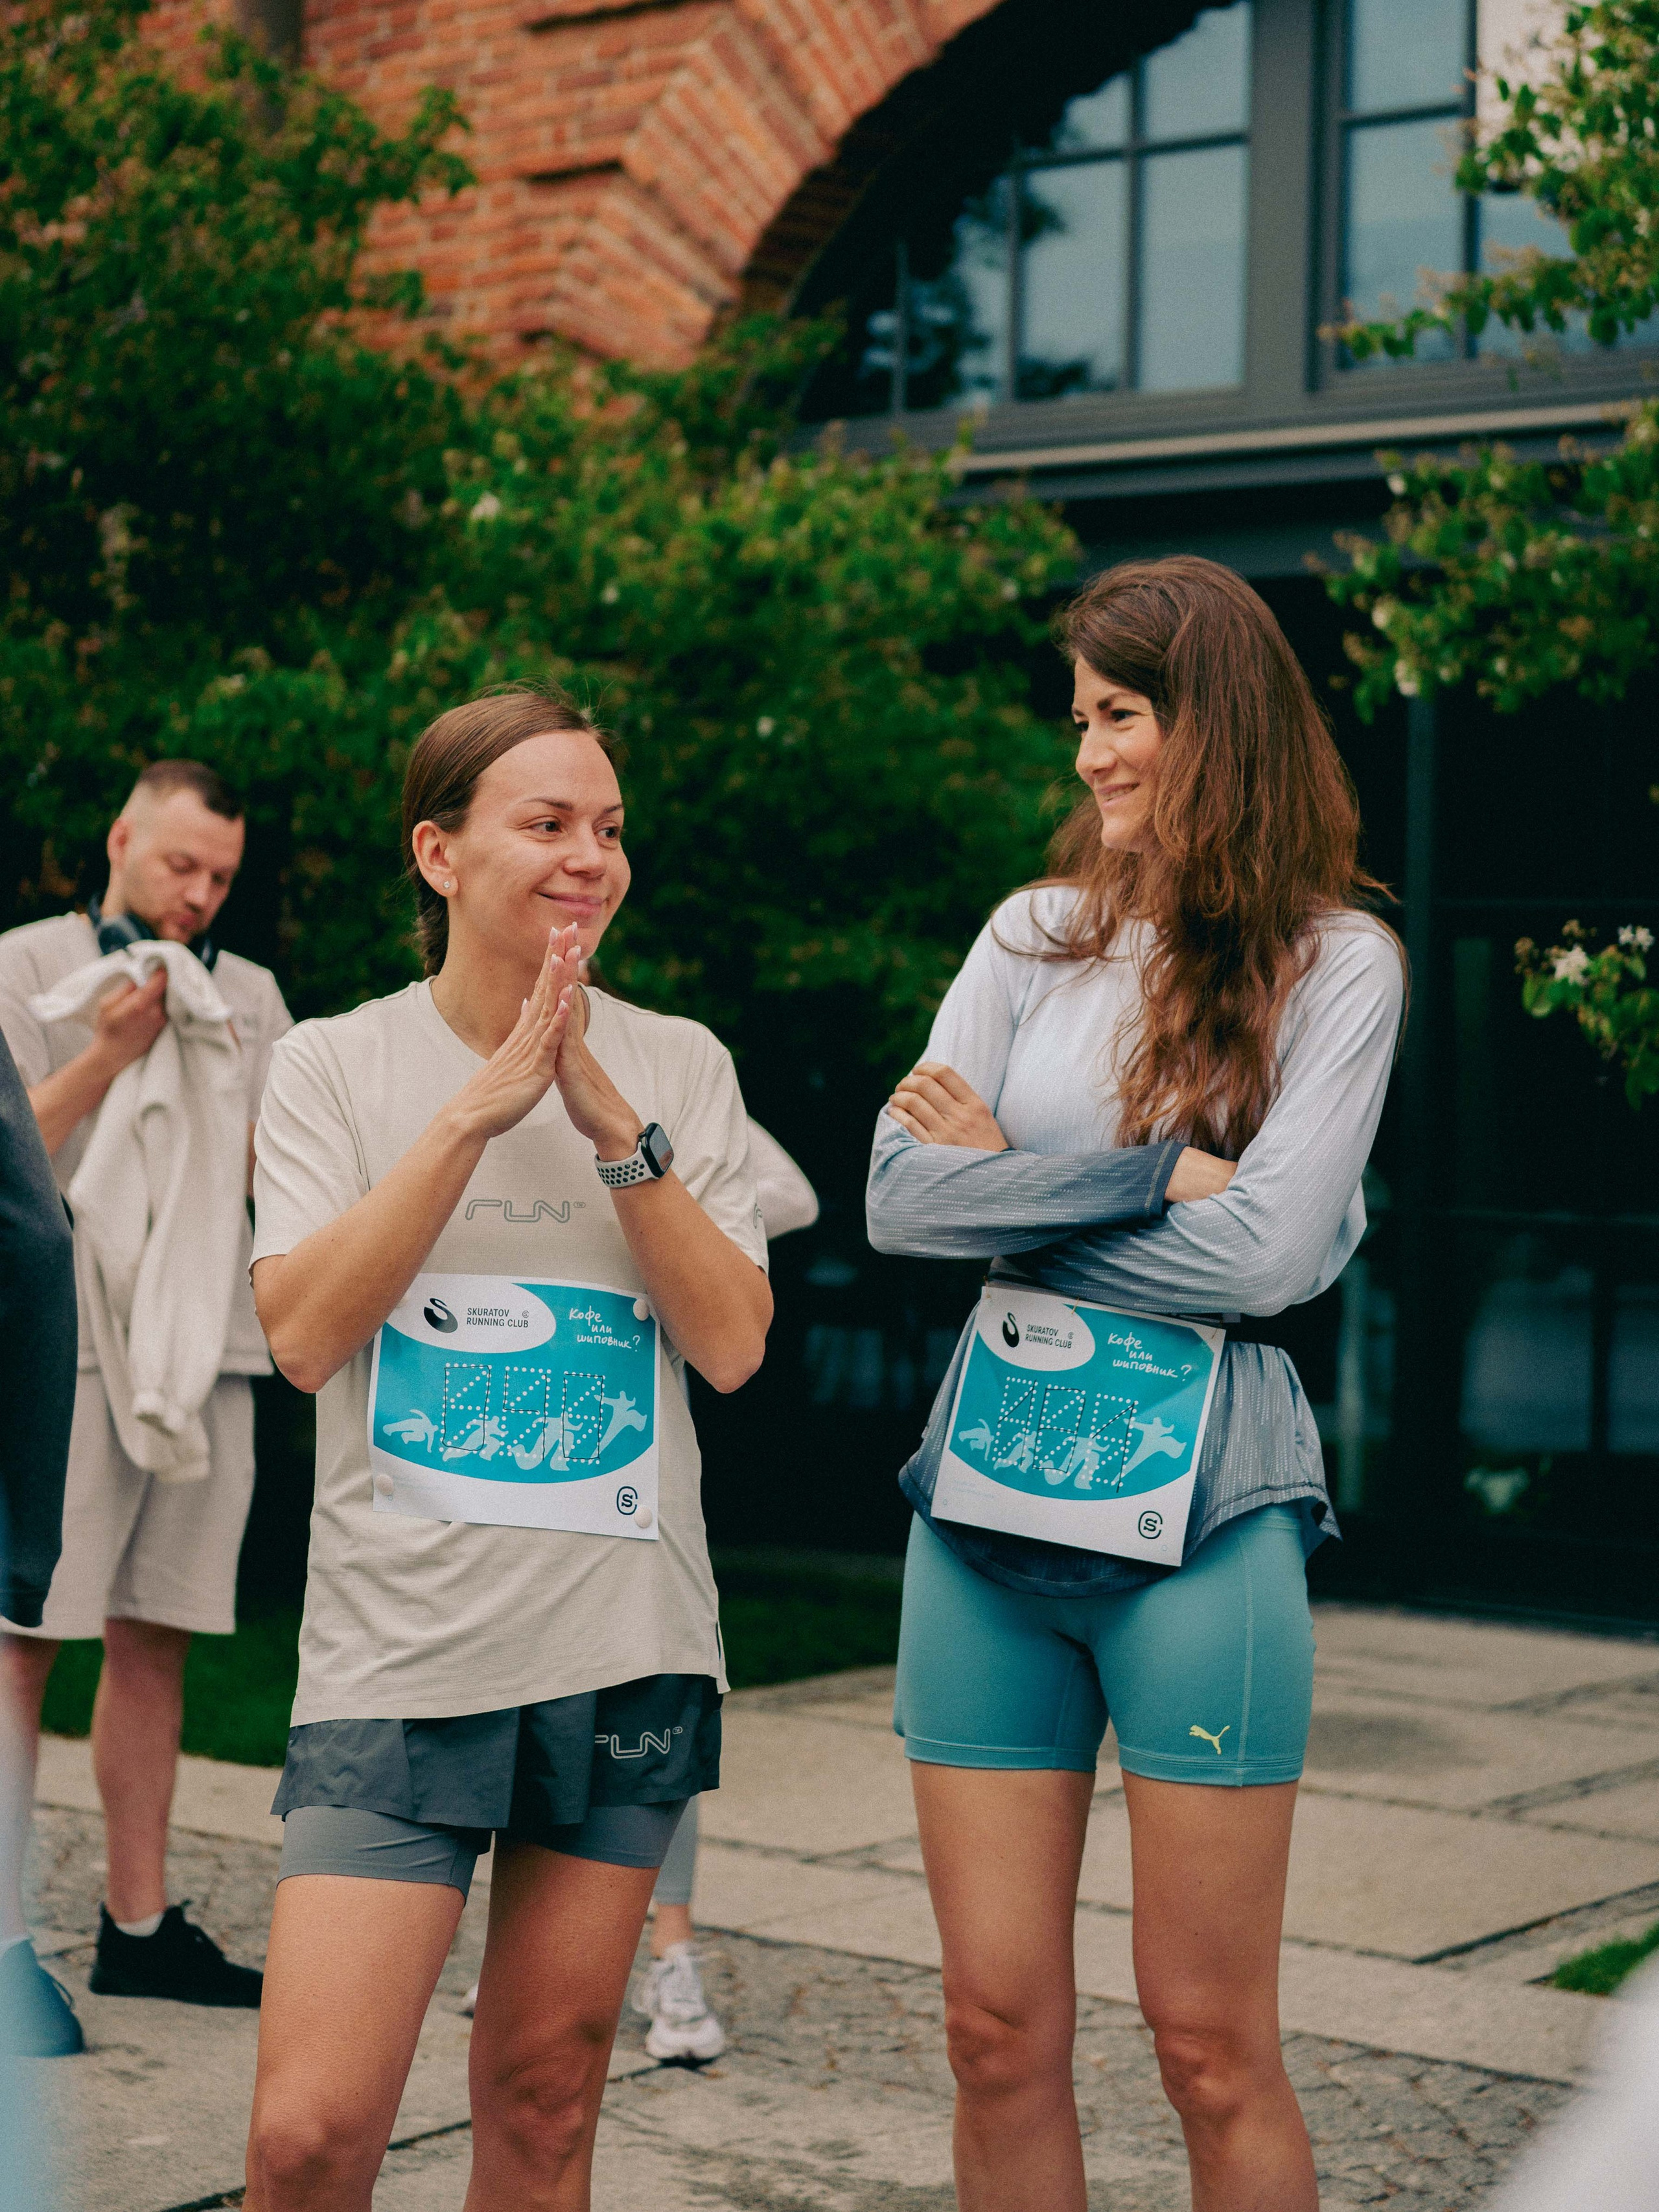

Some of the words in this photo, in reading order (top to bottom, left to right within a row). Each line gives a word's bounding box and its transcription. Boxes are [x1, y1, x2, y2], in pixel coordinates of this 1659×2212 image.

[467, 1307, 510, 1318] SKURATOV
[466, 1317, 505, 1327] RUNNING
[507, 1319, 529, 1328] CLUB
[591, 1324, 612, 1334] или
[1027, 1324, 1059, 1336] SKURATOV
[1025, 1333, 1053, 1345] RUNNING
[1054, 1339, 1073, 1349] CLUB
[1129, 1350, 1153, 1361] или
